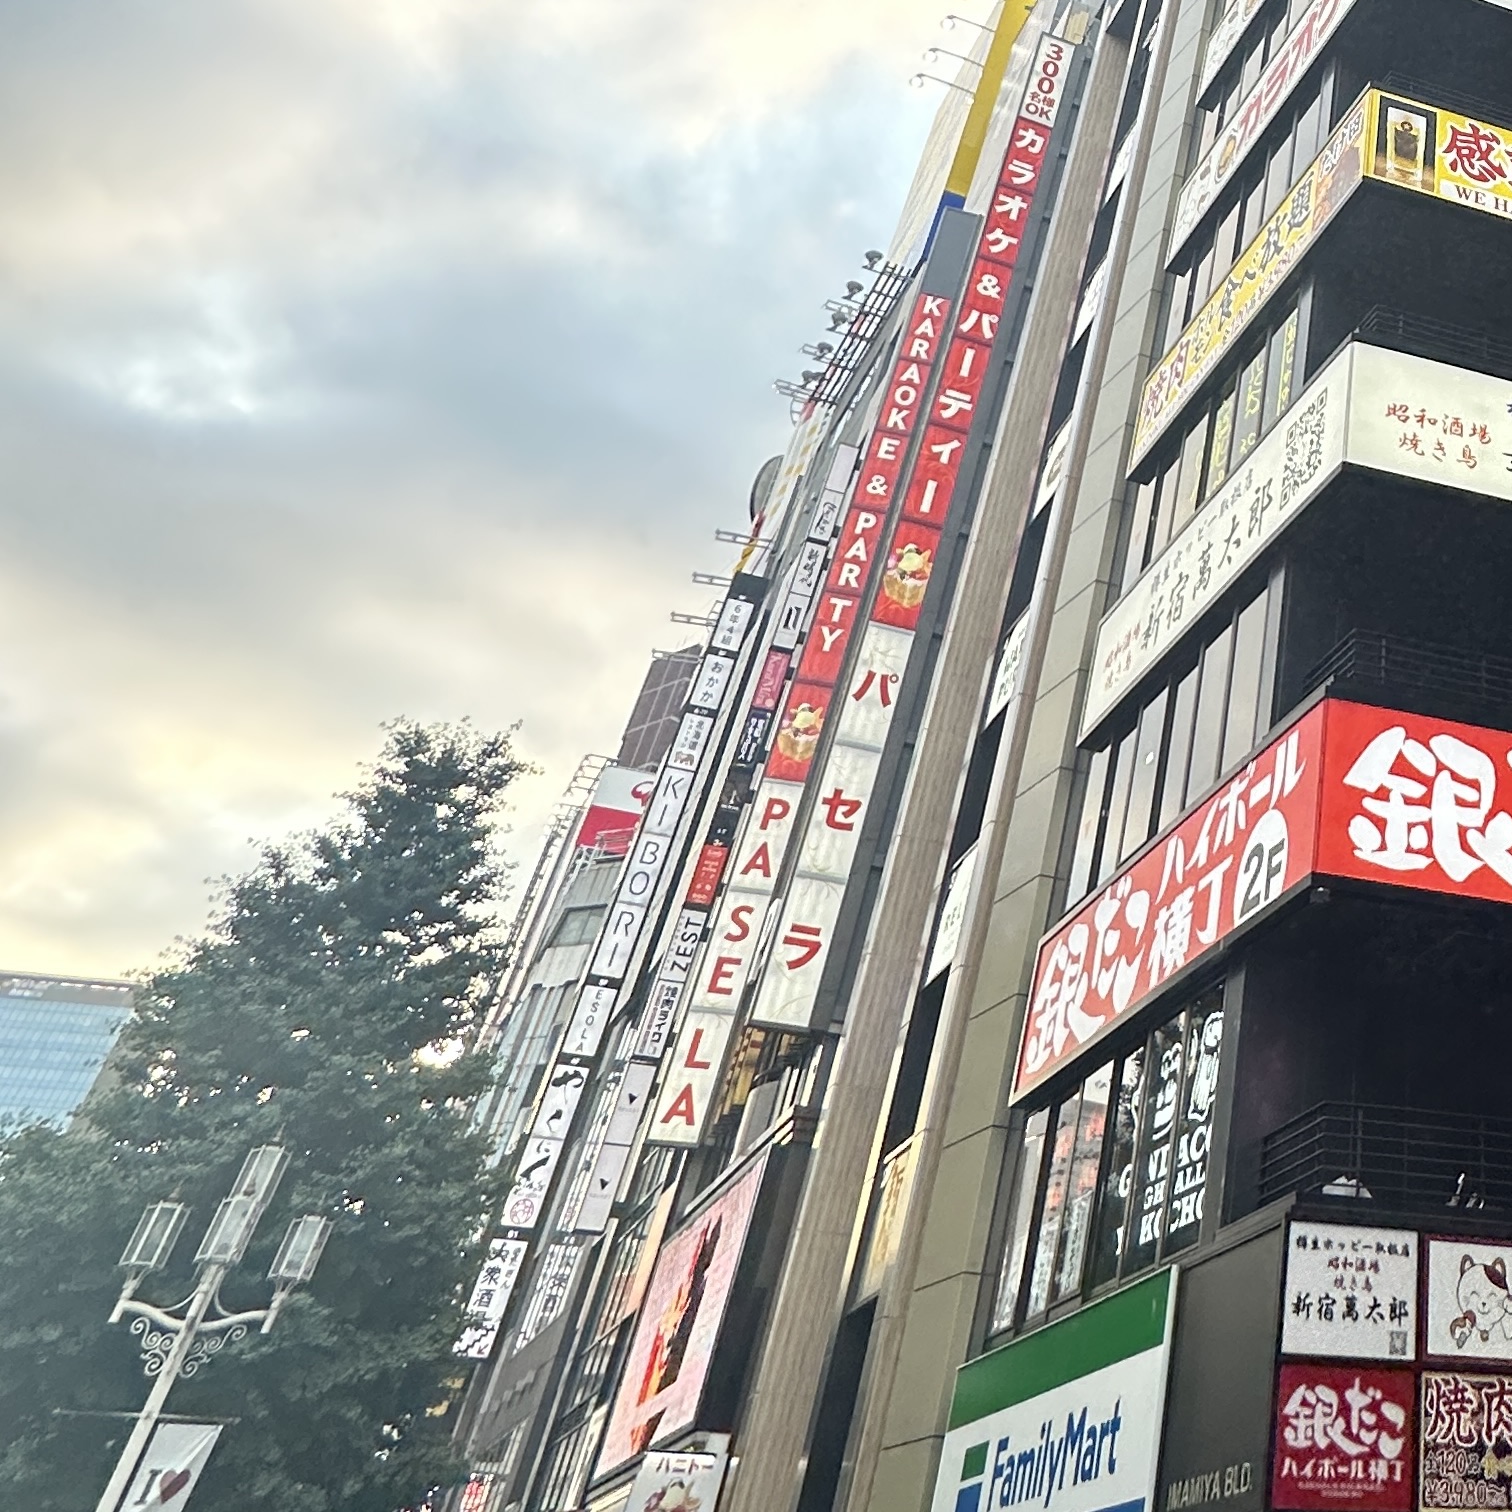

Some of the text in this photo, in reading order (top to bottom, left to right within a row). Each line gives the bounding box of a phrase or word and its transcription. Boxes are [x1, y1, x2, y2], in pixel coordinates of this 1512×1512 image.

[1037, 43, 1065, 95] 300
[1025, 101, 1052, 122] OK
[1455, 187, 1486, 210] WE
[877, 296, 946, 460] KARAOKE
[1385, 403, 1492, 446] 昭和酒場
[1399, 431, 1480, 470] 焼き鳥
[866, 475, 889, 496] &
[820, 512, 878, 653] PARTY
[1141, 478, 1273, 652] 新宿萬太郎
[782, 669, 900, 972] パセラ
[1158, 729, 1307, 900] ハイボール
[606, 774, 686, 969] KIBORI
[1239, 837, 1286, 920] 2F
[661, 797, 791, 1126] PASELA
[672, 917, 706, 974] ZEST
[1148, 854, 1233, 988] 横丁
[1026, 875, 1151, 1074] 銀だこ
[1291, 1292, 1410, 1328] 新宿萬太郎
[988, 1395, 1122, 1512] FamilyMart
[1283, 1377, 1406, 1458] 銀だこ
[1167, 1471, 1221, 1511] IMAMIYA
[1224, 1461, 1253, 1498] BLD.
[1281, 1455, 1406, 1486] ハイボール横丁
